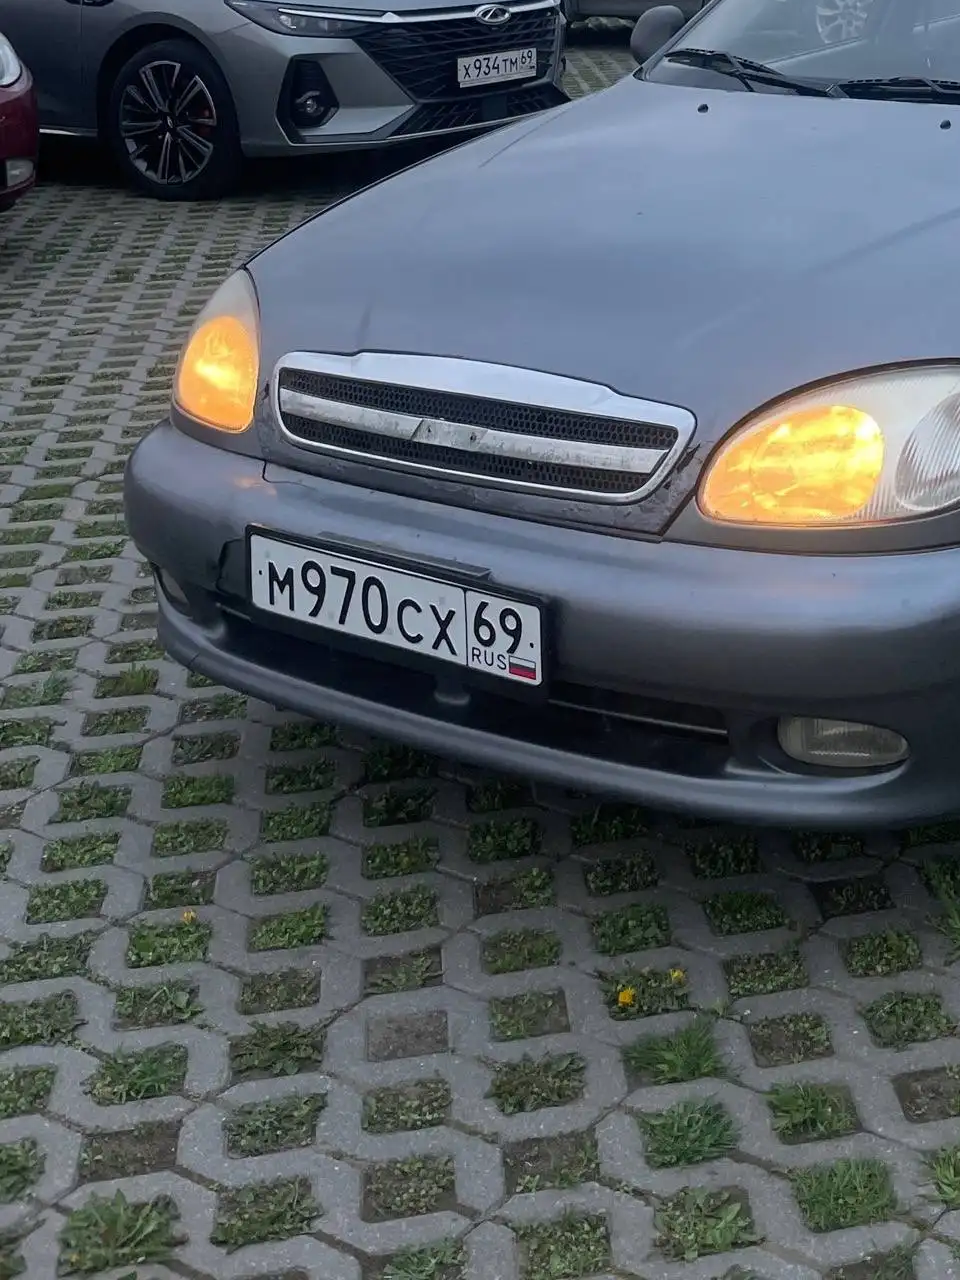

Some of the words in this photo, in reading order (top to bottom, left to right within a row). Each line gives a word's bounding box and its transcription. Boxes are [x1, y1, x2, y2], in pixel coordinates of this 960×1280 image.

[520, 50, 533, 64] 69
[267, 560, 458, 657] М970СХ
[473, 601, 523, 654] 69
[471, 647, 507, 670] RUS
